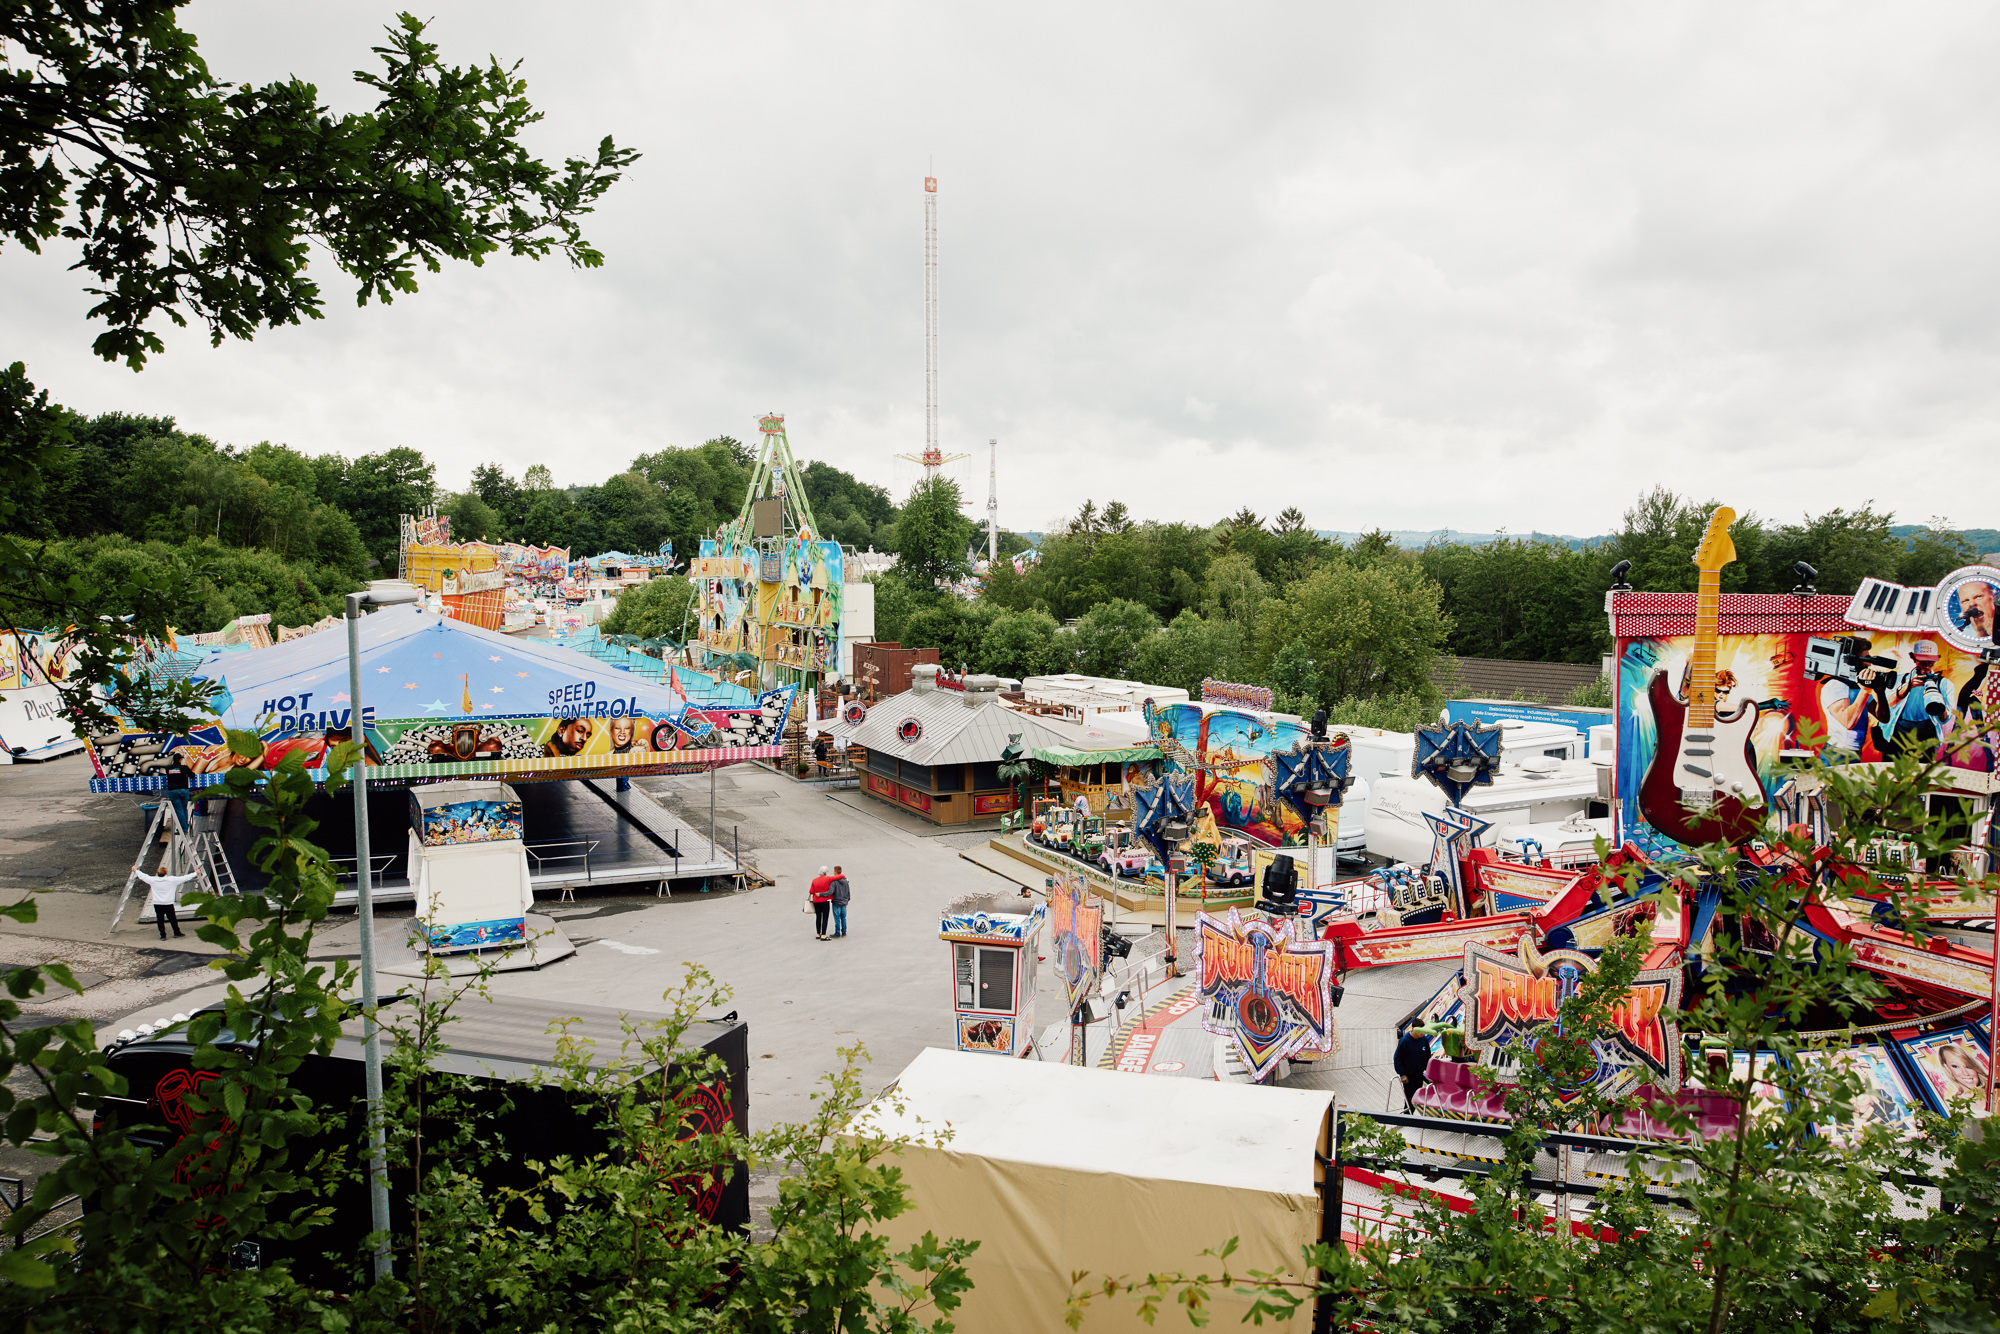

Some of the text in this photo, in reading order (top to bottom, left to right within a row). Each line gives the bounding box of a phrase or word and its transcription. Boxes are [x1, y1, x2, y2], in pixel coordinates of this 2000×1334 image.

[263, 692, 313, 715] HOT
[548, 681, 596, 705] SPEED
[1205, 682, 1270, 710] SAHARARALLY
[22, 700, 55, 722] Play
[280, 706, 376, 732] DRIVE
[552, 696, 643, 720] CONTROL
[1379, 796, 1401, 809] Travel
[1395, 804, 1423, 820] Supreme
[1437, 822, 1447, 836] 12
[1462, 816, 1470, 828] 11
[1201, 922, 1325, 1032] DEVIL ROCK
[1475, 957, 1559, 1034] DEVIL
